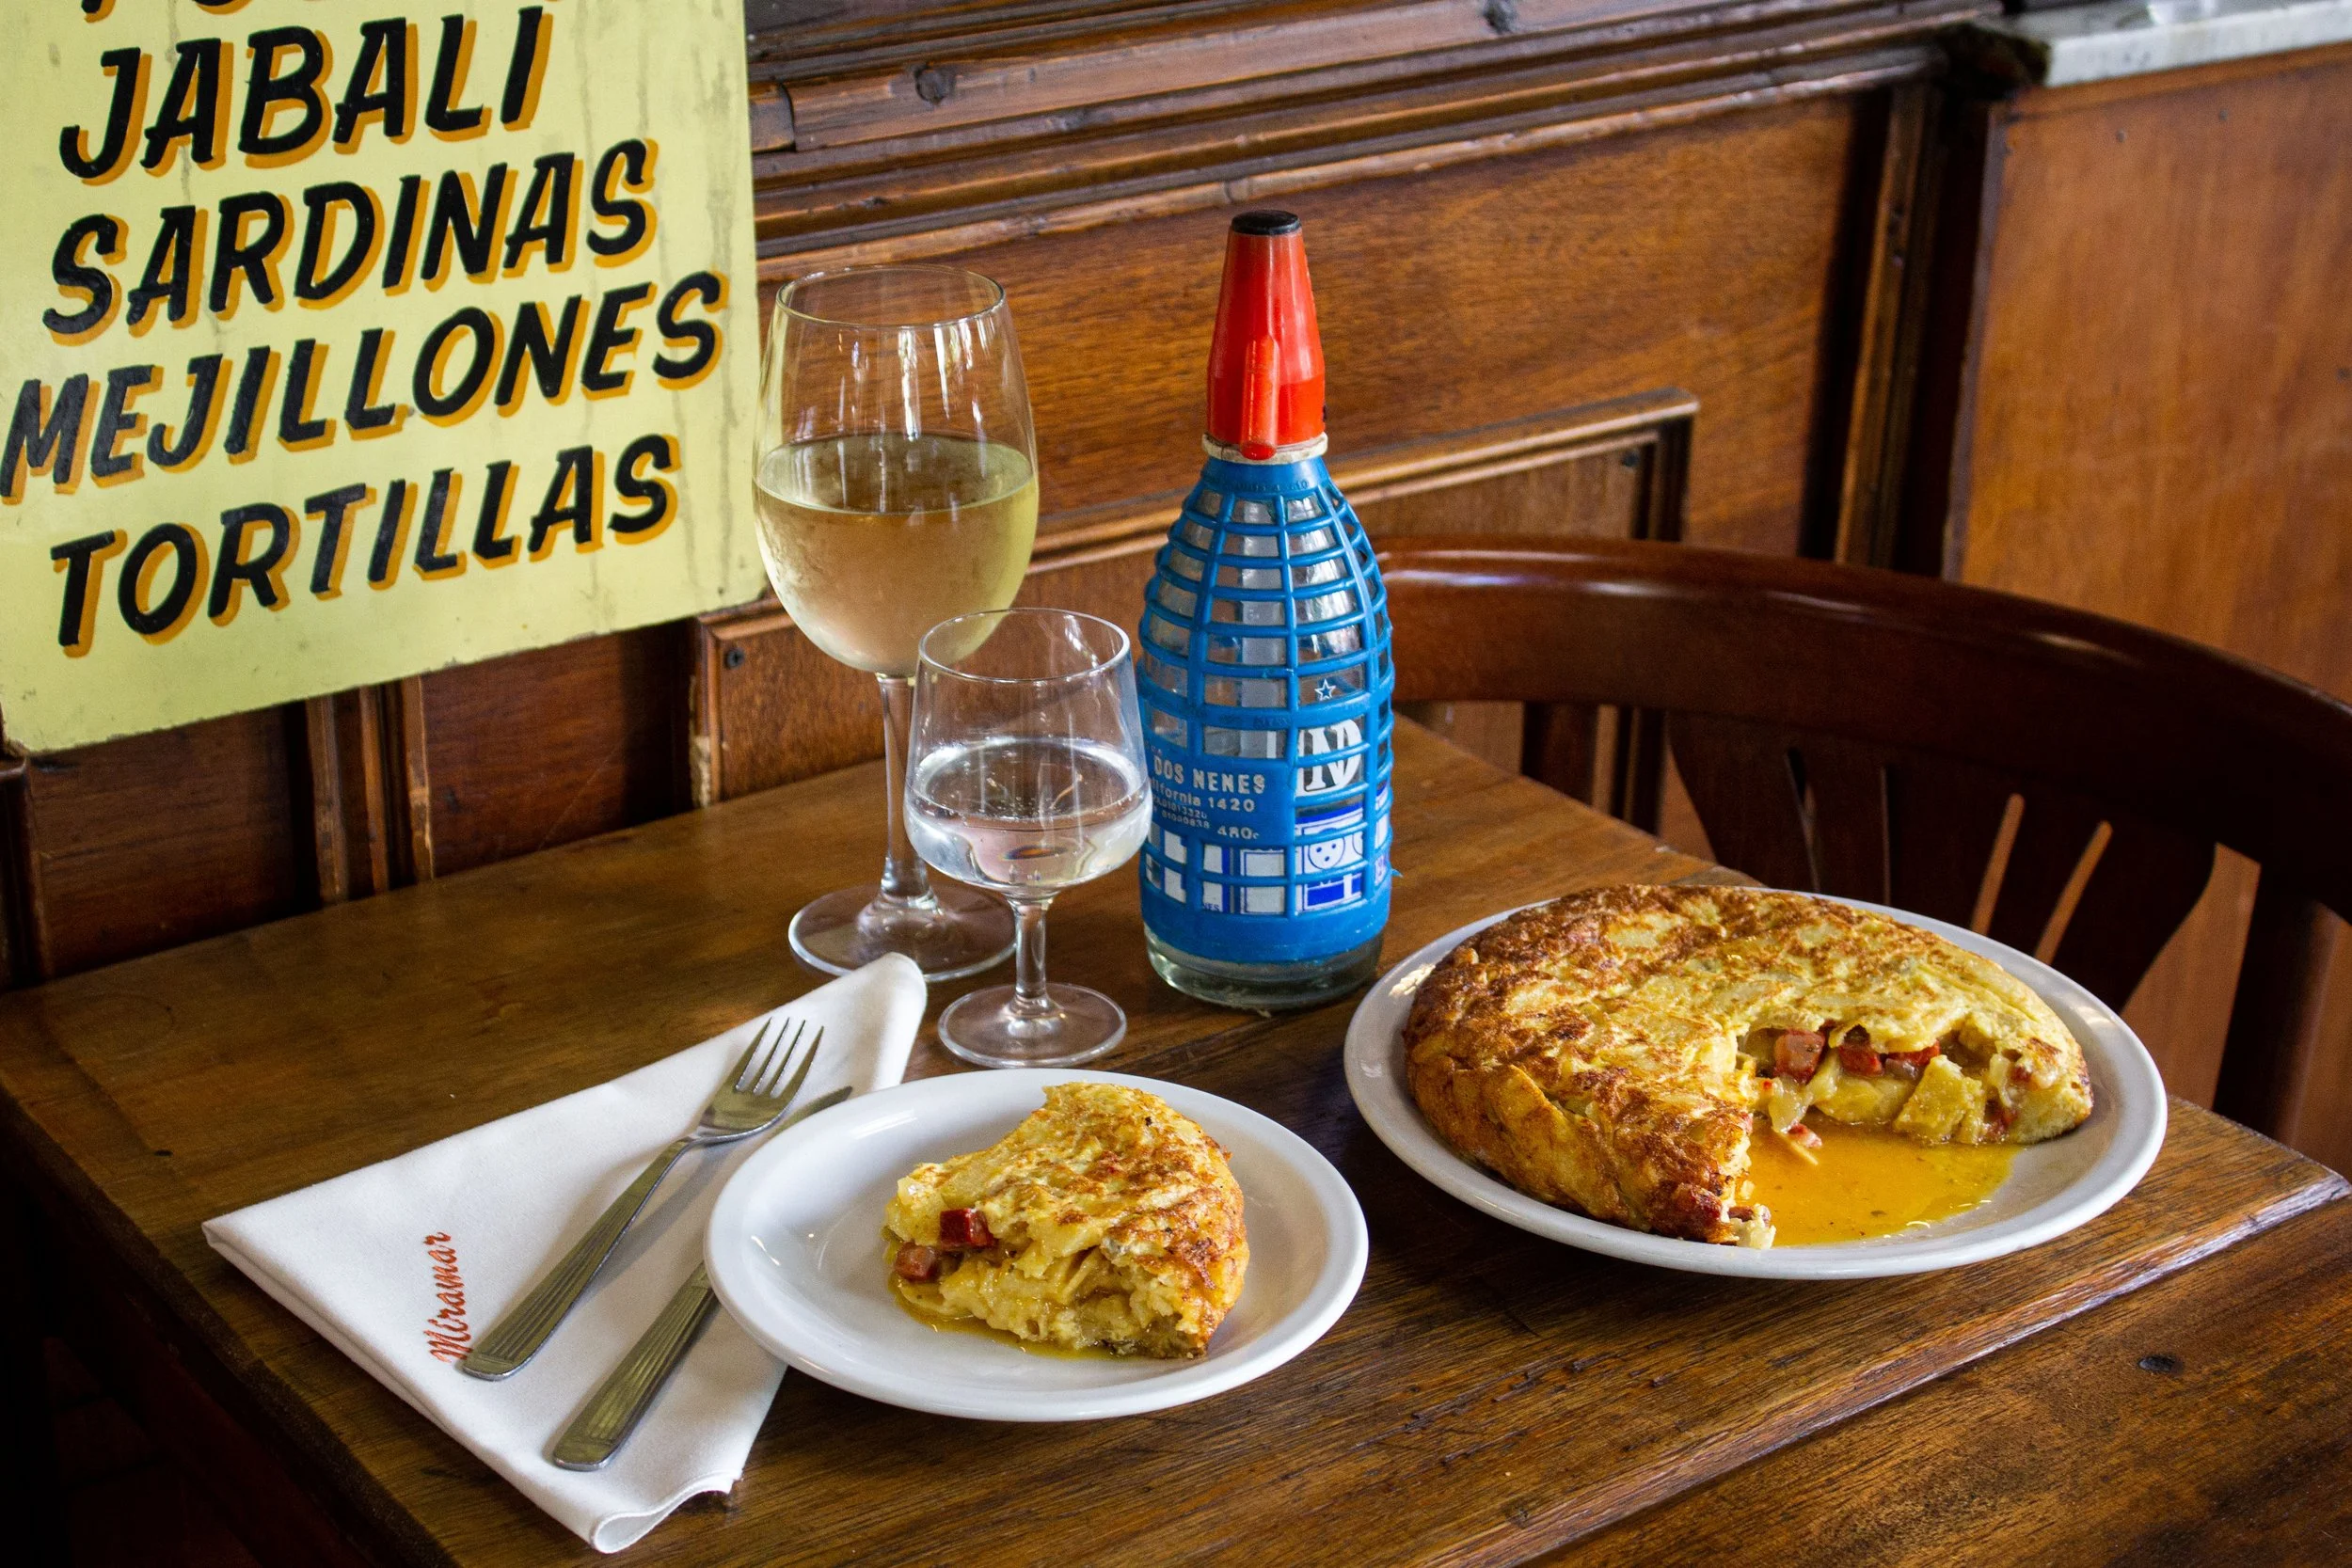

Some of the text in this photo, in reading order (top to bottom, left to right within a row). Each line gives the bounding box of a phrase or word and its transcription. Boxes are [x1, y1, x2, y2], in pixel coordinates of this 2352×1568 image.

[59, 6, 551, 184] JABALI
[42, 138, 659, 344] SARDINAS
[0, 270, 729, 505] MEJILLONES
[50, 435, 681, 657] TORTILLAS
[1152, 777, 1201, 806] lifornia
[1154, 755, 1265, 794] DOS NENES
[423, 1230, 473, 1363] Miramar
